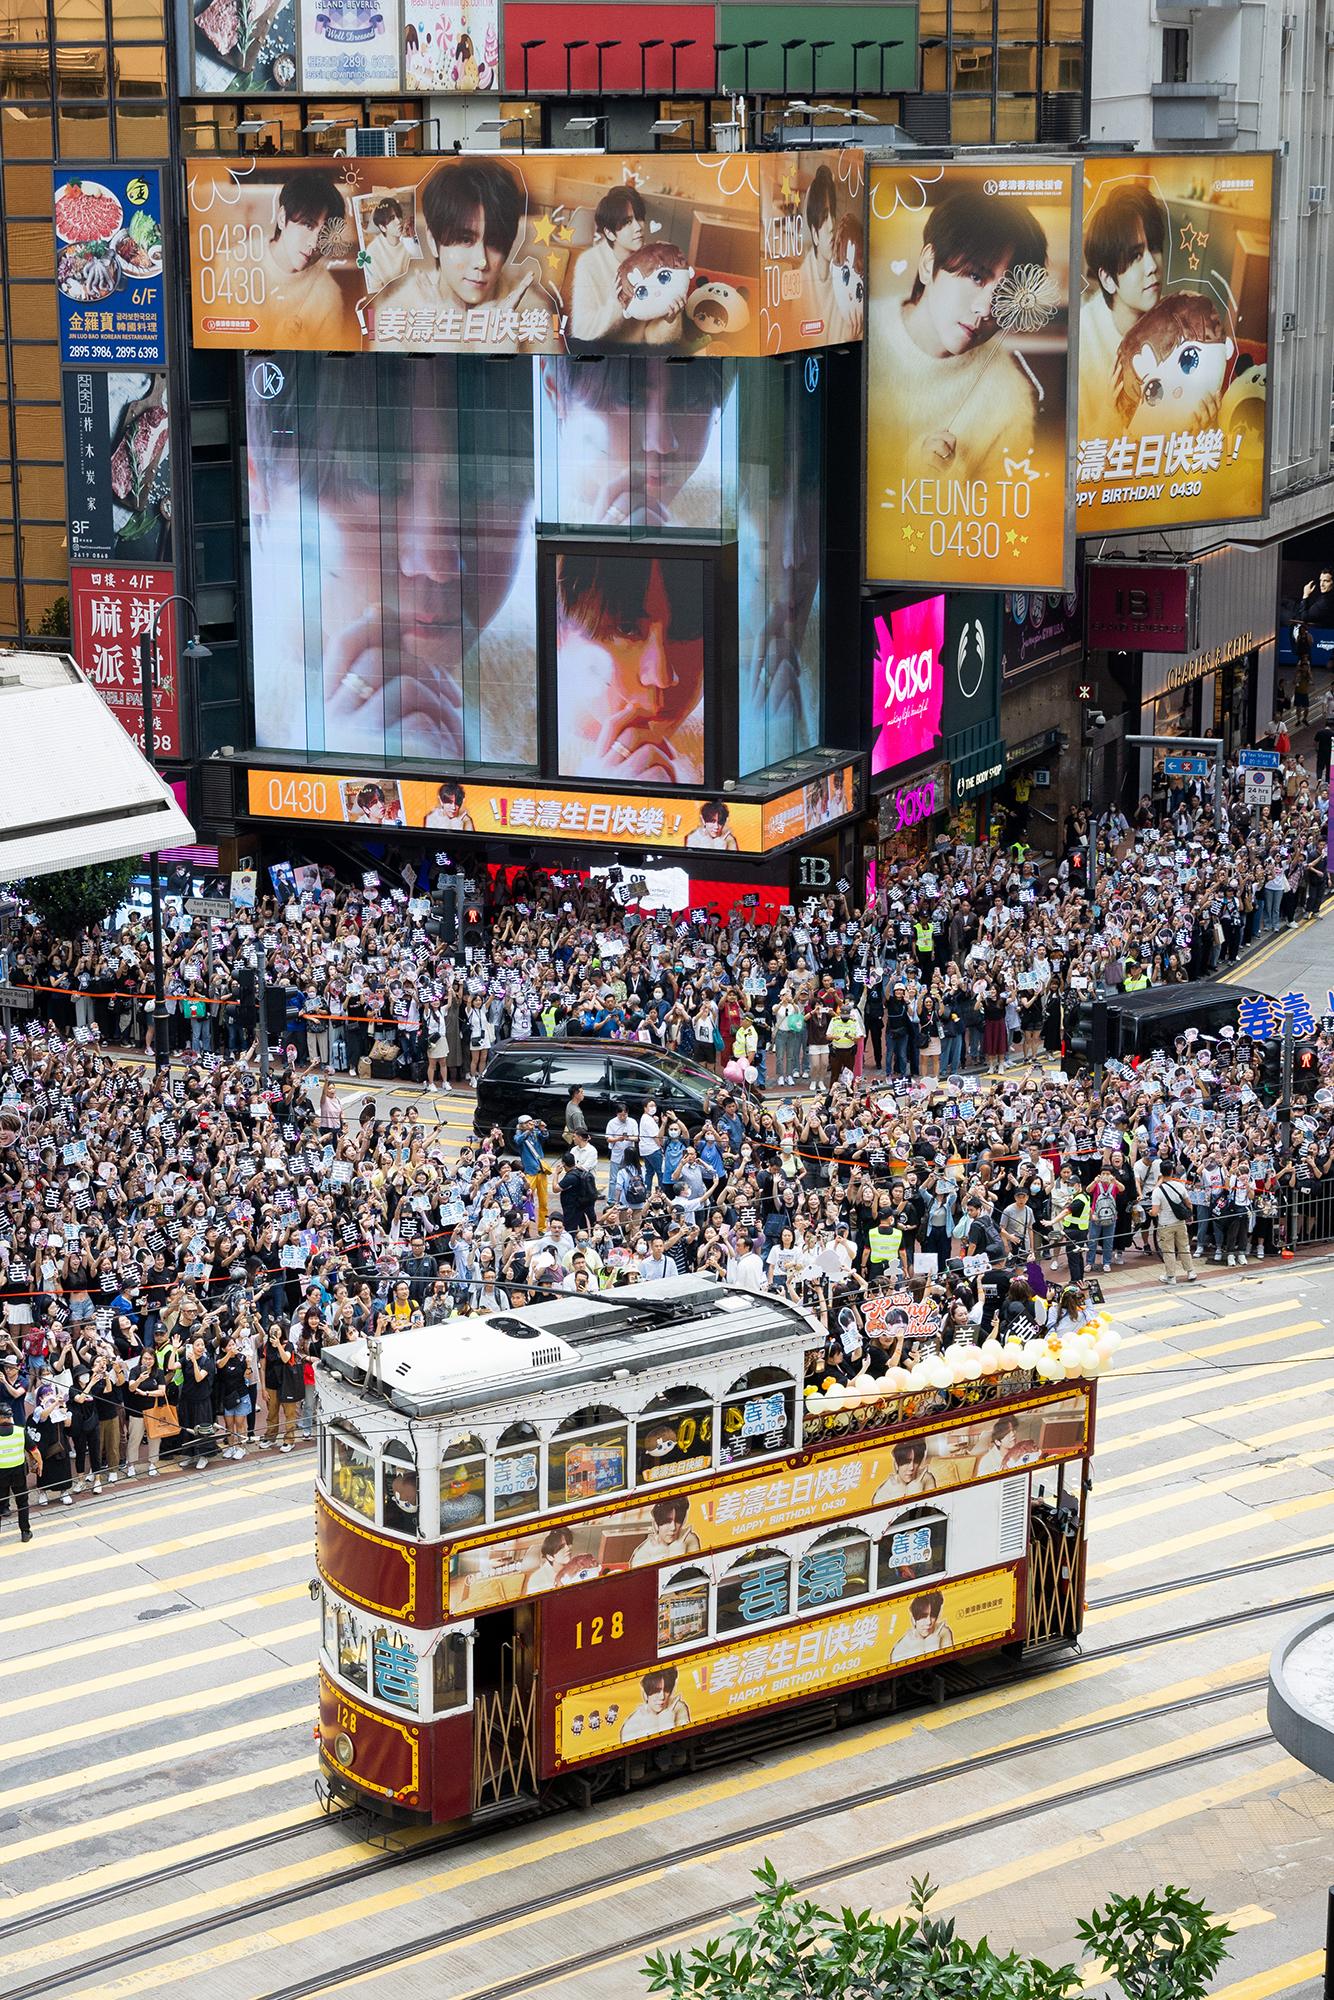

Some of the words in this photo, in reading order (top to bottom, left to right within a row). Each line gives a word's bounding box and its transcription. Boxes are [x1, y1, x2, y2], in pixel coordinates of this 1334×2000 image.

[199, 224, 265, 262] 0430
[763, 214, 803, 261] KEUNG
[132, 289, 157, 305] 6/F
[201, 266, 266, 304] 0430
[765, 265, 781, 308] TO
[68, 311, 114, 332] 金羅寶
[69, 346, 90, 358] 2895
[115, 346, 136, 358] 2895
[138, 346, 159, 359] 6398
[901, 478, 988, 518] KEUNG
[996, 481, 1031, 520] TO
[1101, 483, 1165, 505] BIRTHDAY
[1169, 480, 1202, 498] 0430
[72, 520, 90, 534] 3F
[929, 521, 1000, 559] 0430
[129, 574, 154, 589] 4/F
[90, 596, 162, 638] 麻辣
[1167, 650, 1211, 691] CHARLES
[1226, 631, 1253, 663] KEITH
[126, 692, 163, 708] PATY
[965, 775, 975, 790] THE
[975, 770, 988, 786] BODY
[988, 763, 1003, 780] SHOP
[268, 778, 327, 814] 0430
[731, 1518, 766, 1536] HAPPY
[769, 1505, 817, 1525] BIRTHDAY
[821, 1497, 847, 1512] 0430
[575, 1610, 625, 1650] 128
[728, 1684, 768, 1705] HAPPY
[771, 1667, 826, 1691] BIRTHDAY
[832, 1657, 861, 1674] 0430
[337, 1703, 357, 1734] 128
